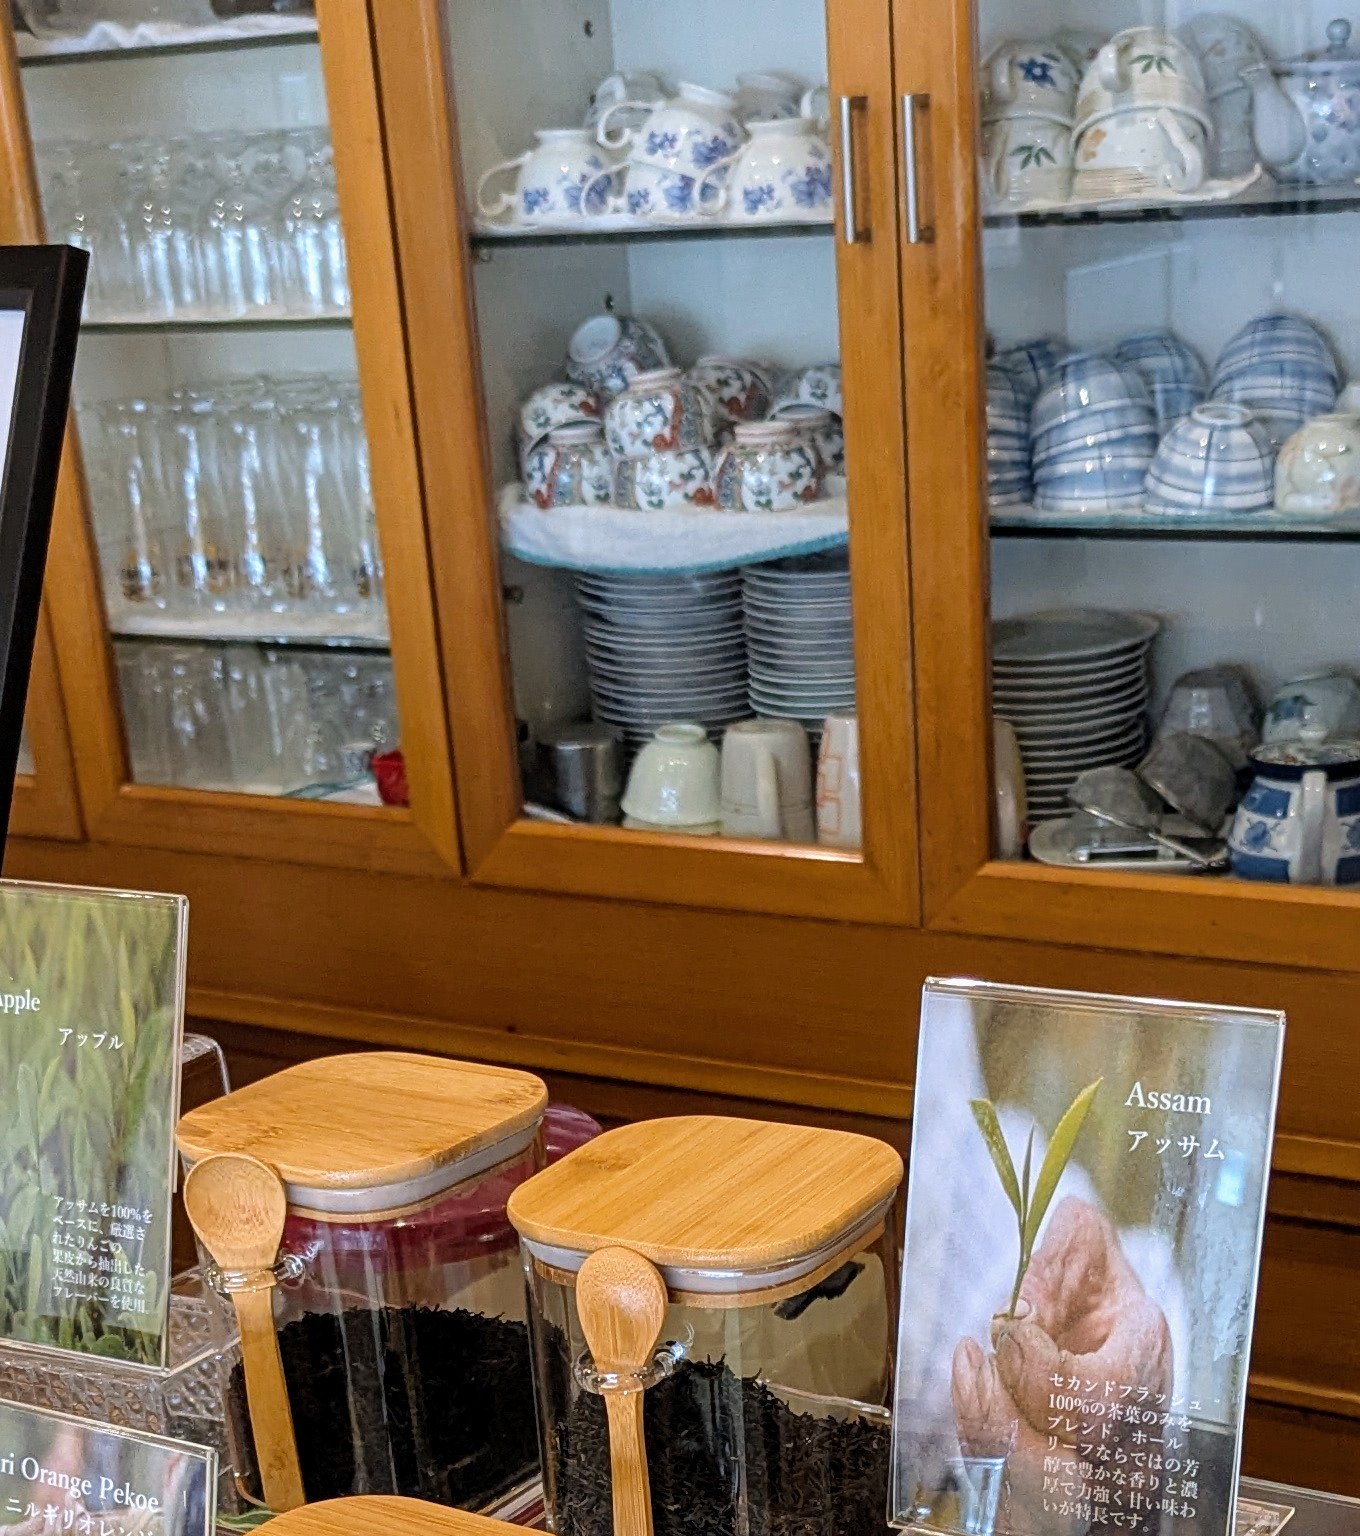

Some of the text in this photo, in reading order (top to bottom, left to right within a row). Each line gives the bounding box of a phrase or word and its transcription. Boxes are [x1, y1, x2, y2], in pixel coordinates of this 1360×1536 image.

[59, 1027, 124, 1051] アップル
[1125, 1081, 1212, 1117] Assam
[1127, 1128, 1226, 1161] アッサム
[1049, 1373, 1202, 1411] セカンドフラッシュ
[1049, 1393, 1192, 1432] 100%の茶葉のみを
[1048, 1435, 1200, 1477] リーフならではの芳
[20, 1455, 92, 1499] Orange
[99, 1475, 159, 1513] Pekoe
[1043, 1455, 1198, 1499] 醇で豊かな香りと濃
[1042, 1476, 1196, 1518] 厚で力強く甘い味わ
[1043, 1499, 1150, 1533] いが特長です。
